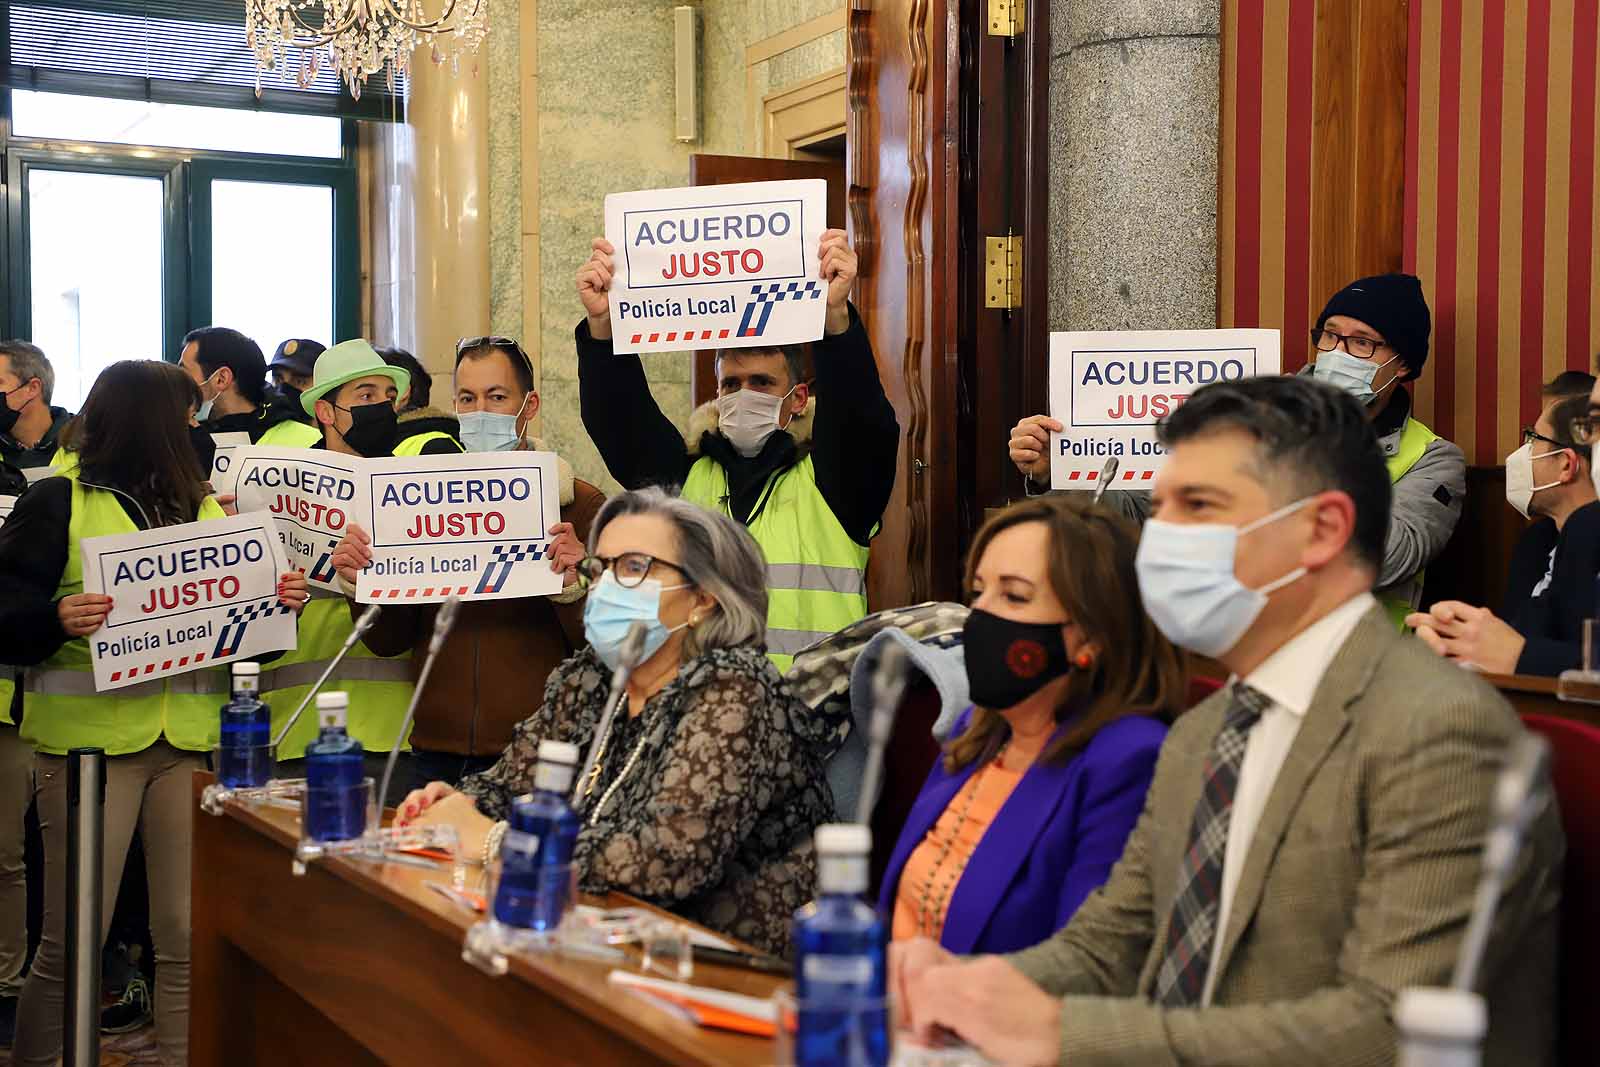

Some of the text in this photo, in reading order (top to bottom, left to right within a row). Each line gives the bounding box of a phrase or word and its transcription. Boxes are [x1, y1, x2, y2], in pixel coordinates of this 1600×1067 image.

[635, 212, 791, 247] ACUERDO
[662, 248, 763, 280] JUSTO
[619, 296, 736, 319] Policía Local
[1082, 359, 1244, 386] ACUERDO
[1107, 394, 1190, 419] JUST
[1060, 438, 1168, 456] Policía Loc
[244, 466, 355, 501] ACUERD
[381, 477, 531, 507] ACUERDO
[269, 495, 346, 531] JUSTO
[406, 511, 506, 539] JUSTO
[114, 539, 264, 586] ACUERDO
[363, 554, 478, 576] Policía Local
[141, 575, 241, 614] JUSTO
[97, 620, 213, 659] Policía Local
